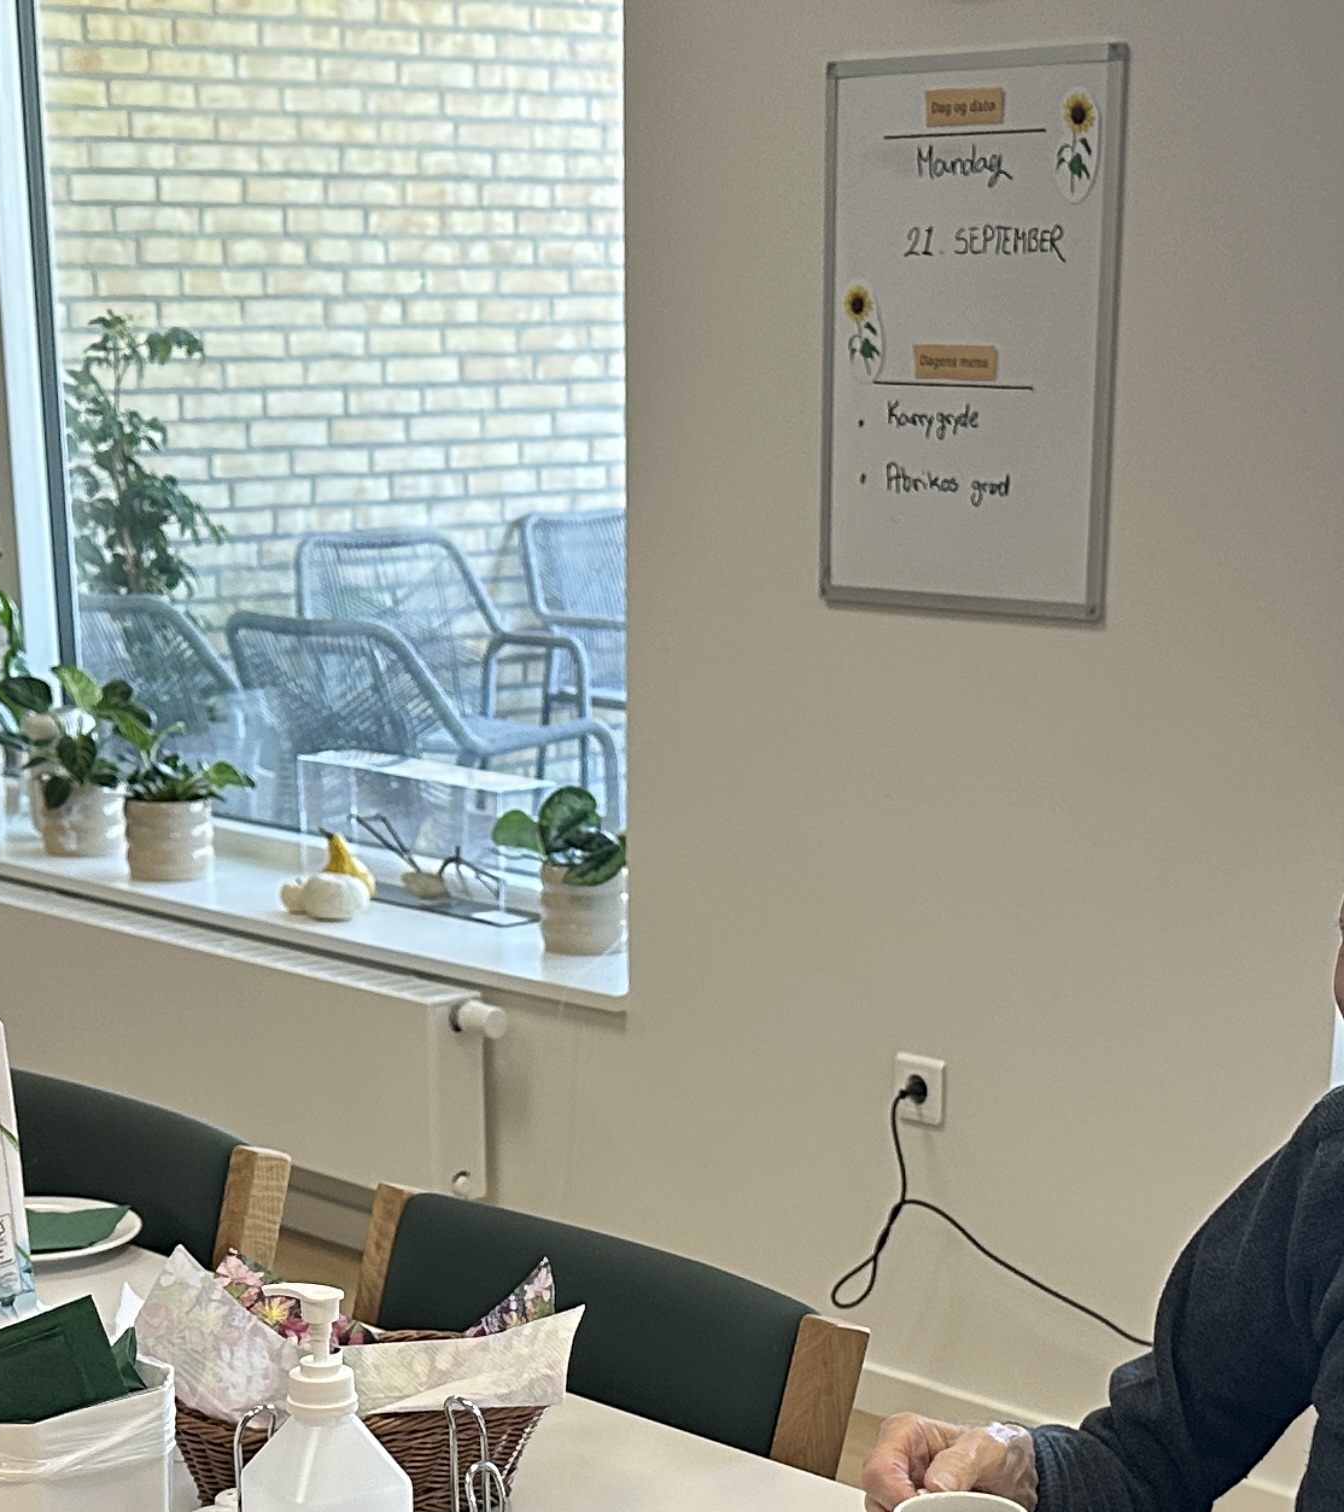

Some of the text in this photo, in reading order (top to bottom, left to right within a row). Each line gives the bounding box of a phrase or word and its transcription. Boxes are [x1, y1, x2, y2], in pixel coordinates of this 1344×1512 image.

[931, 101, 952, 116] Dag
[916, 143, 1014, 189] Mandag
[953, 223, 1067, 264] SEPTEMBER
